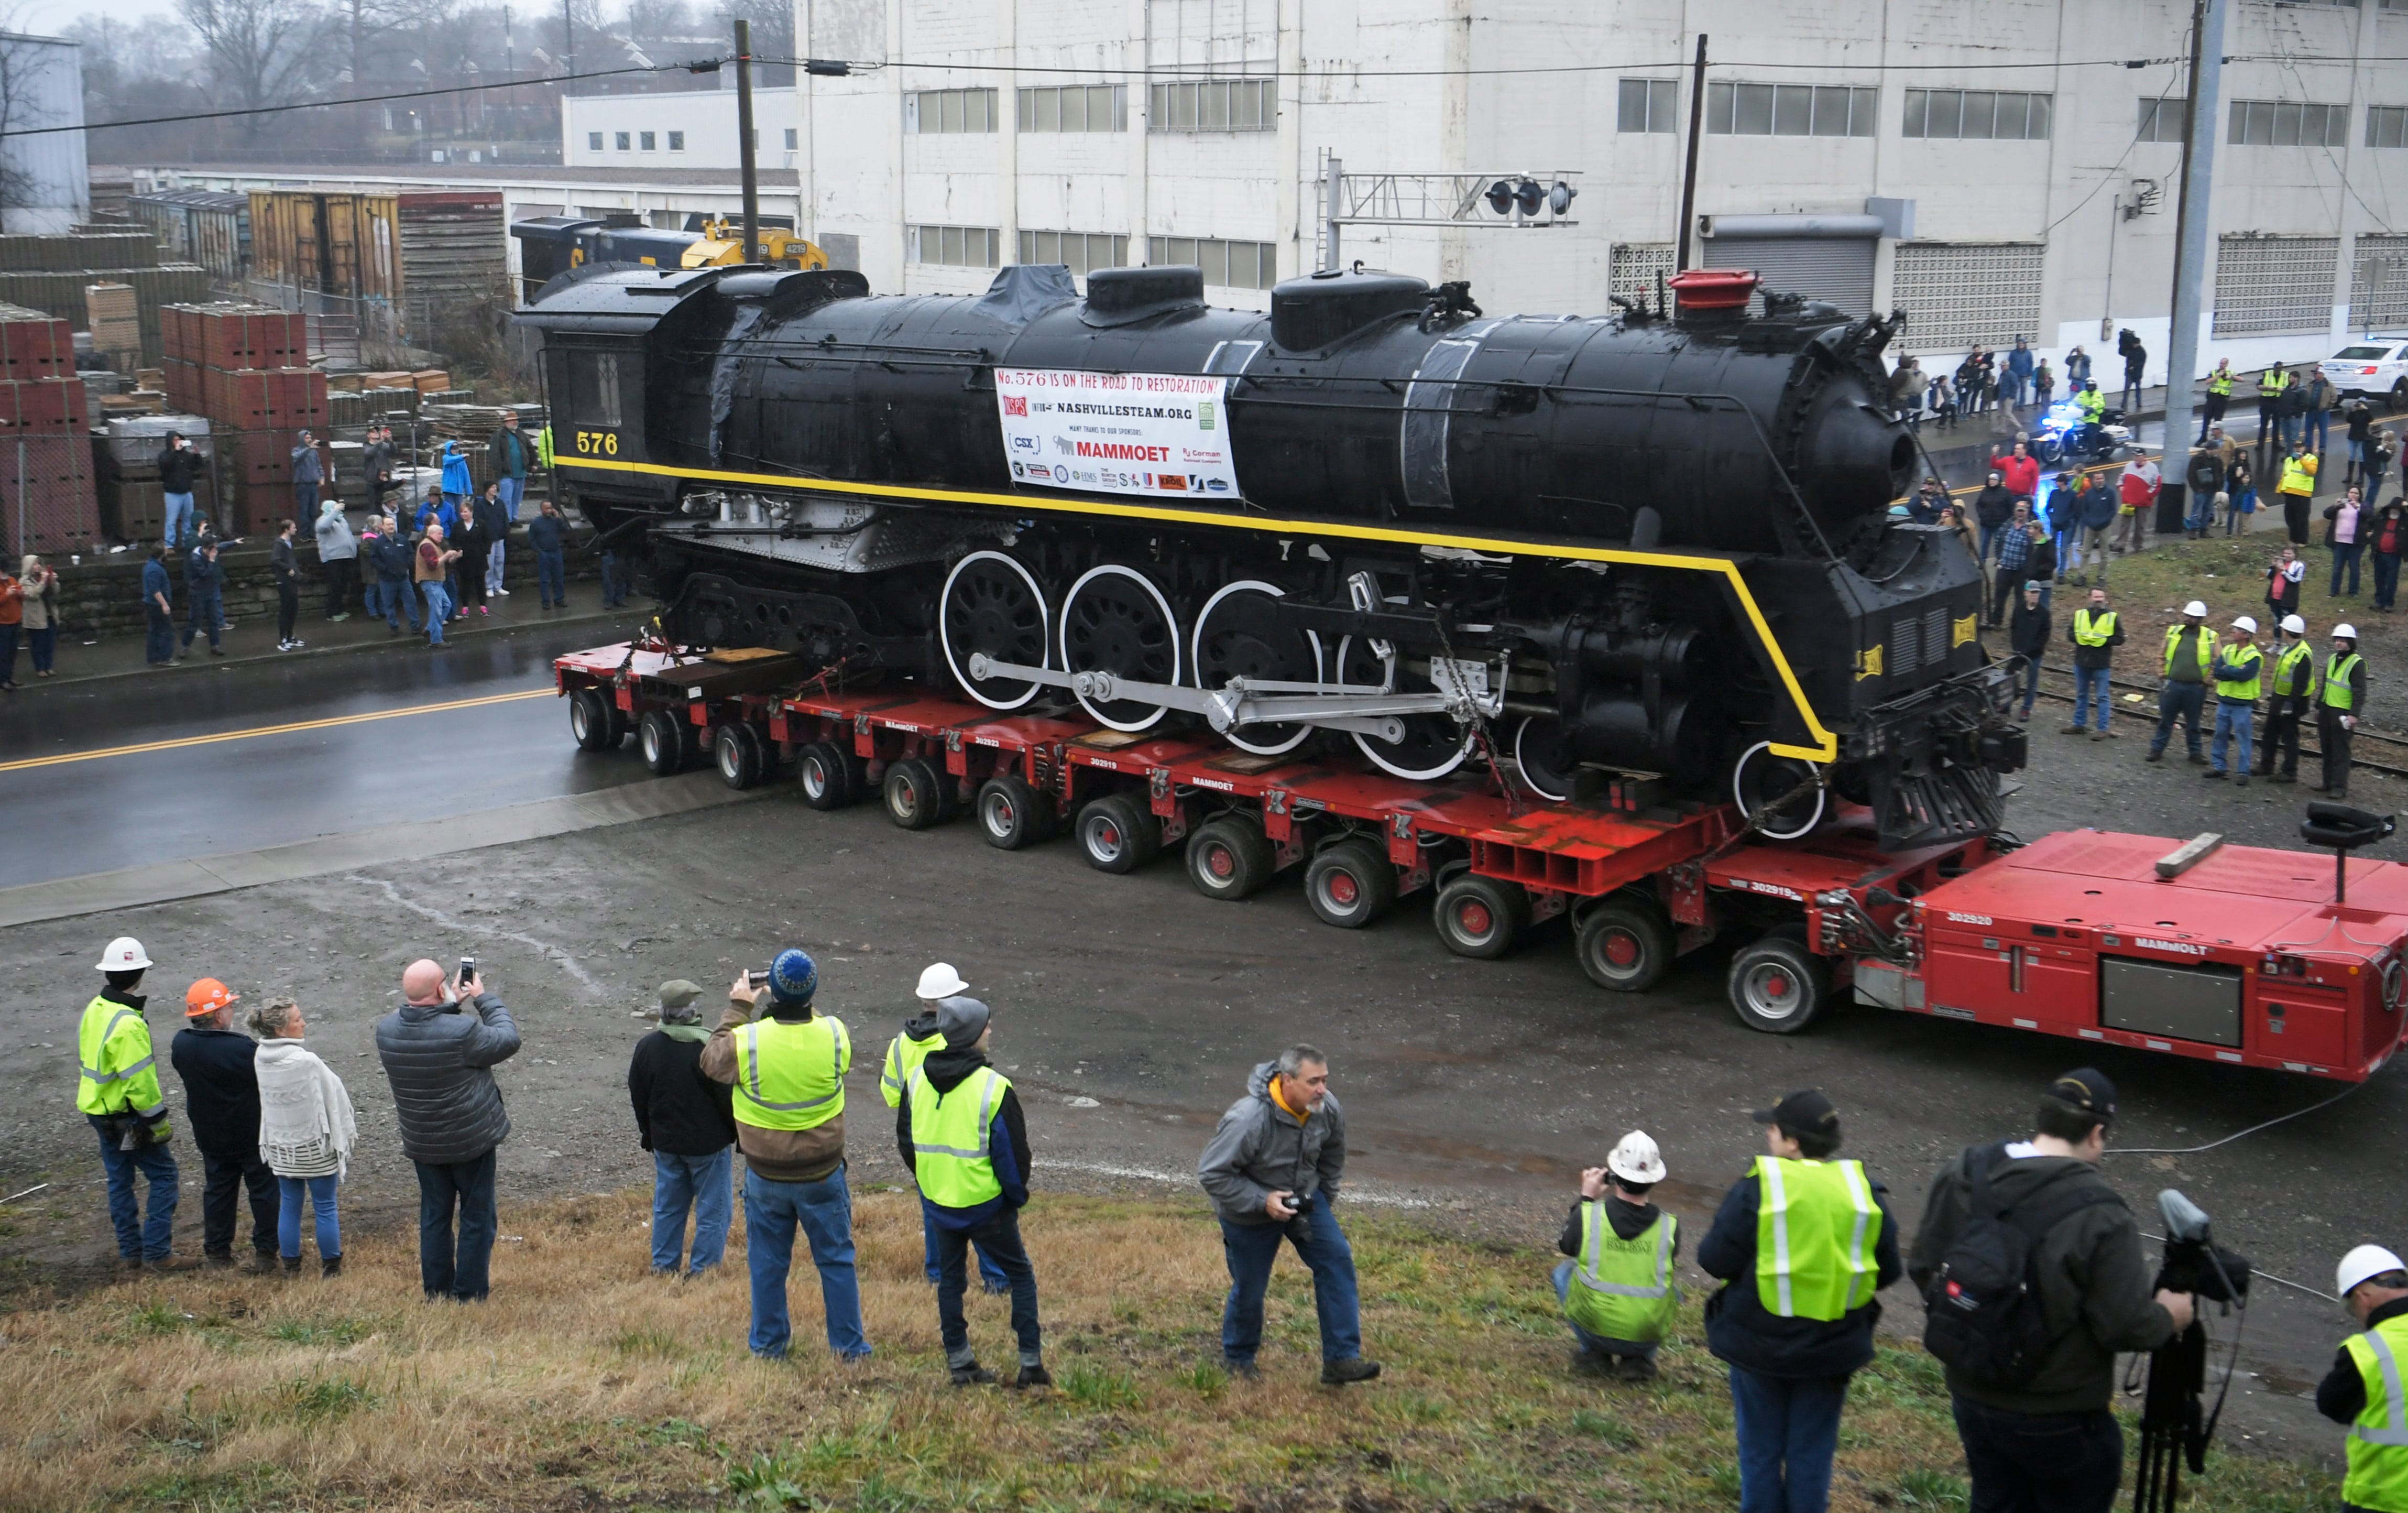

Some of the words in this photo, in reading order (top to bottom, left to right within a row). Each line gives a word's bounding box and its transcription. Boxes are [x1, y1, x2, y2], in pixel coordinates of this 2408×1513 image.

[786, 244, 806, 253] 4219
[998, 371, 1013, 384] No.
[1016, 372, 1046, 386] 576
[1050, 373, 1059, 387] IS
[1064, 374, 1076, 388] ON
[1081, 375, 1097, 389] THE
[1102, 376, 1127, 390] ROAD
[1132, 377, 1143, 390] TO
[1147, 377, 1218, 394] RESTORATION!
[1005, 397, 1025, 415] NSPS
[1057, 402, 1192, 420] NASHVILLESTEAM.ORG
[1083, 426, 1099, 434] THANKS
[1119, 428, 1143, 437] SPONSORS:
[577, 431, 618, 455] 576
[1015, 437, 1033, 449] CSX
[1077, 441, 1169, 462] MAMMOET
[1192, 449, 1221, 458] Corman
[1081, 472, 1097, 481] HMS
[1159, 477, 1185, 487] KROIL
[885, 721, 918, 733] MAMMOET
[975, 736, 999, 747] 302923
[1090, 757, 1117, 769] 302919
[1192, 777, 1233, 791] MAMMOET
[1752, 881, 1792, 897] 302919
[1946, 911, 1993, 926] 302920
[2135, 937, 2207, 955] MAMMOET
